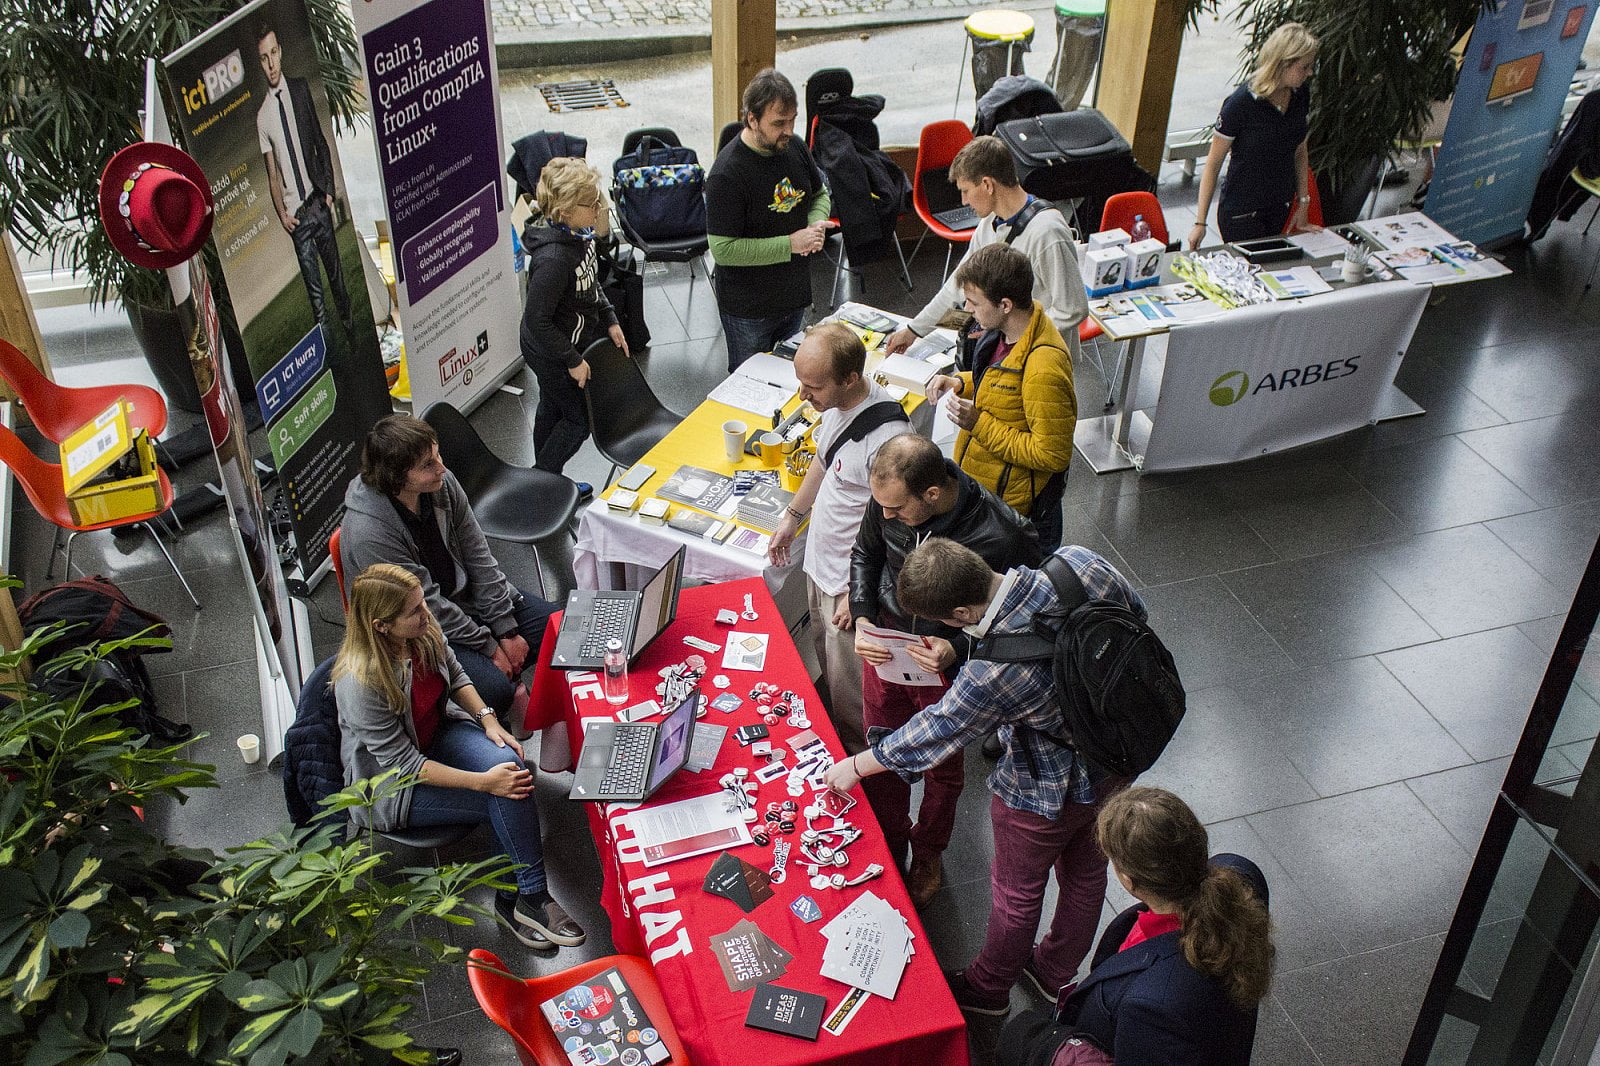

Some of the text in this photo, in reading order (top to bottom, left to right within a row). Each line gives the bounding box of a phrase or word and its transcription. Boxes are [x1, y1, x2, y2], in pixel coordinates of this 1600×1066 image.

[374, 37, 423, 76] Gain 3
[378, 36, 480, 109] Qualifications
[383, 60, 485, 136] from CompTIA
[386, 122, 438, 165] Linux+
[230, 163, 248, 181] firma
[394, 154, 473, 209] Certified Linux Administrator
[411, 171, 426, 184] from
[425, 163, 435, 176] LPI
[246, 190, 258, 209] jak
[396, 187, 440, 223] (CLA) from SUSE
[417, 206, 481, 256] Enhance employability
[420, 224, 474, 269] Globally recognised
[421, 241, 473, 283] Validate your skills
[281, 364, 295, 383] ICT
[294, 343, 317, 369] kurzy
[1252, 355, 1362, 395] ARBES
[293, 409, 310, 429] Soft
[309, 389, 329, 414] skills
[627, 871, 694, 967] HAT
[723, 938, 749, 981] SHAPE
[738, 945, 751, 967] FUTURE
[740, 934, 763, 977] OPENSTACK
[747, 967, 756, 979] THE
[849, 942, 863, 967] PURPOSE
[857, 944, 869, 967] PASSION
[860, 946, 875, 978] COMMUNITY
[865, 948, 881, 985] OPPORTUNITY
[774, 994, 789, 1022] IDEAS
[782, 995, 795, 1023] THAT CAN
